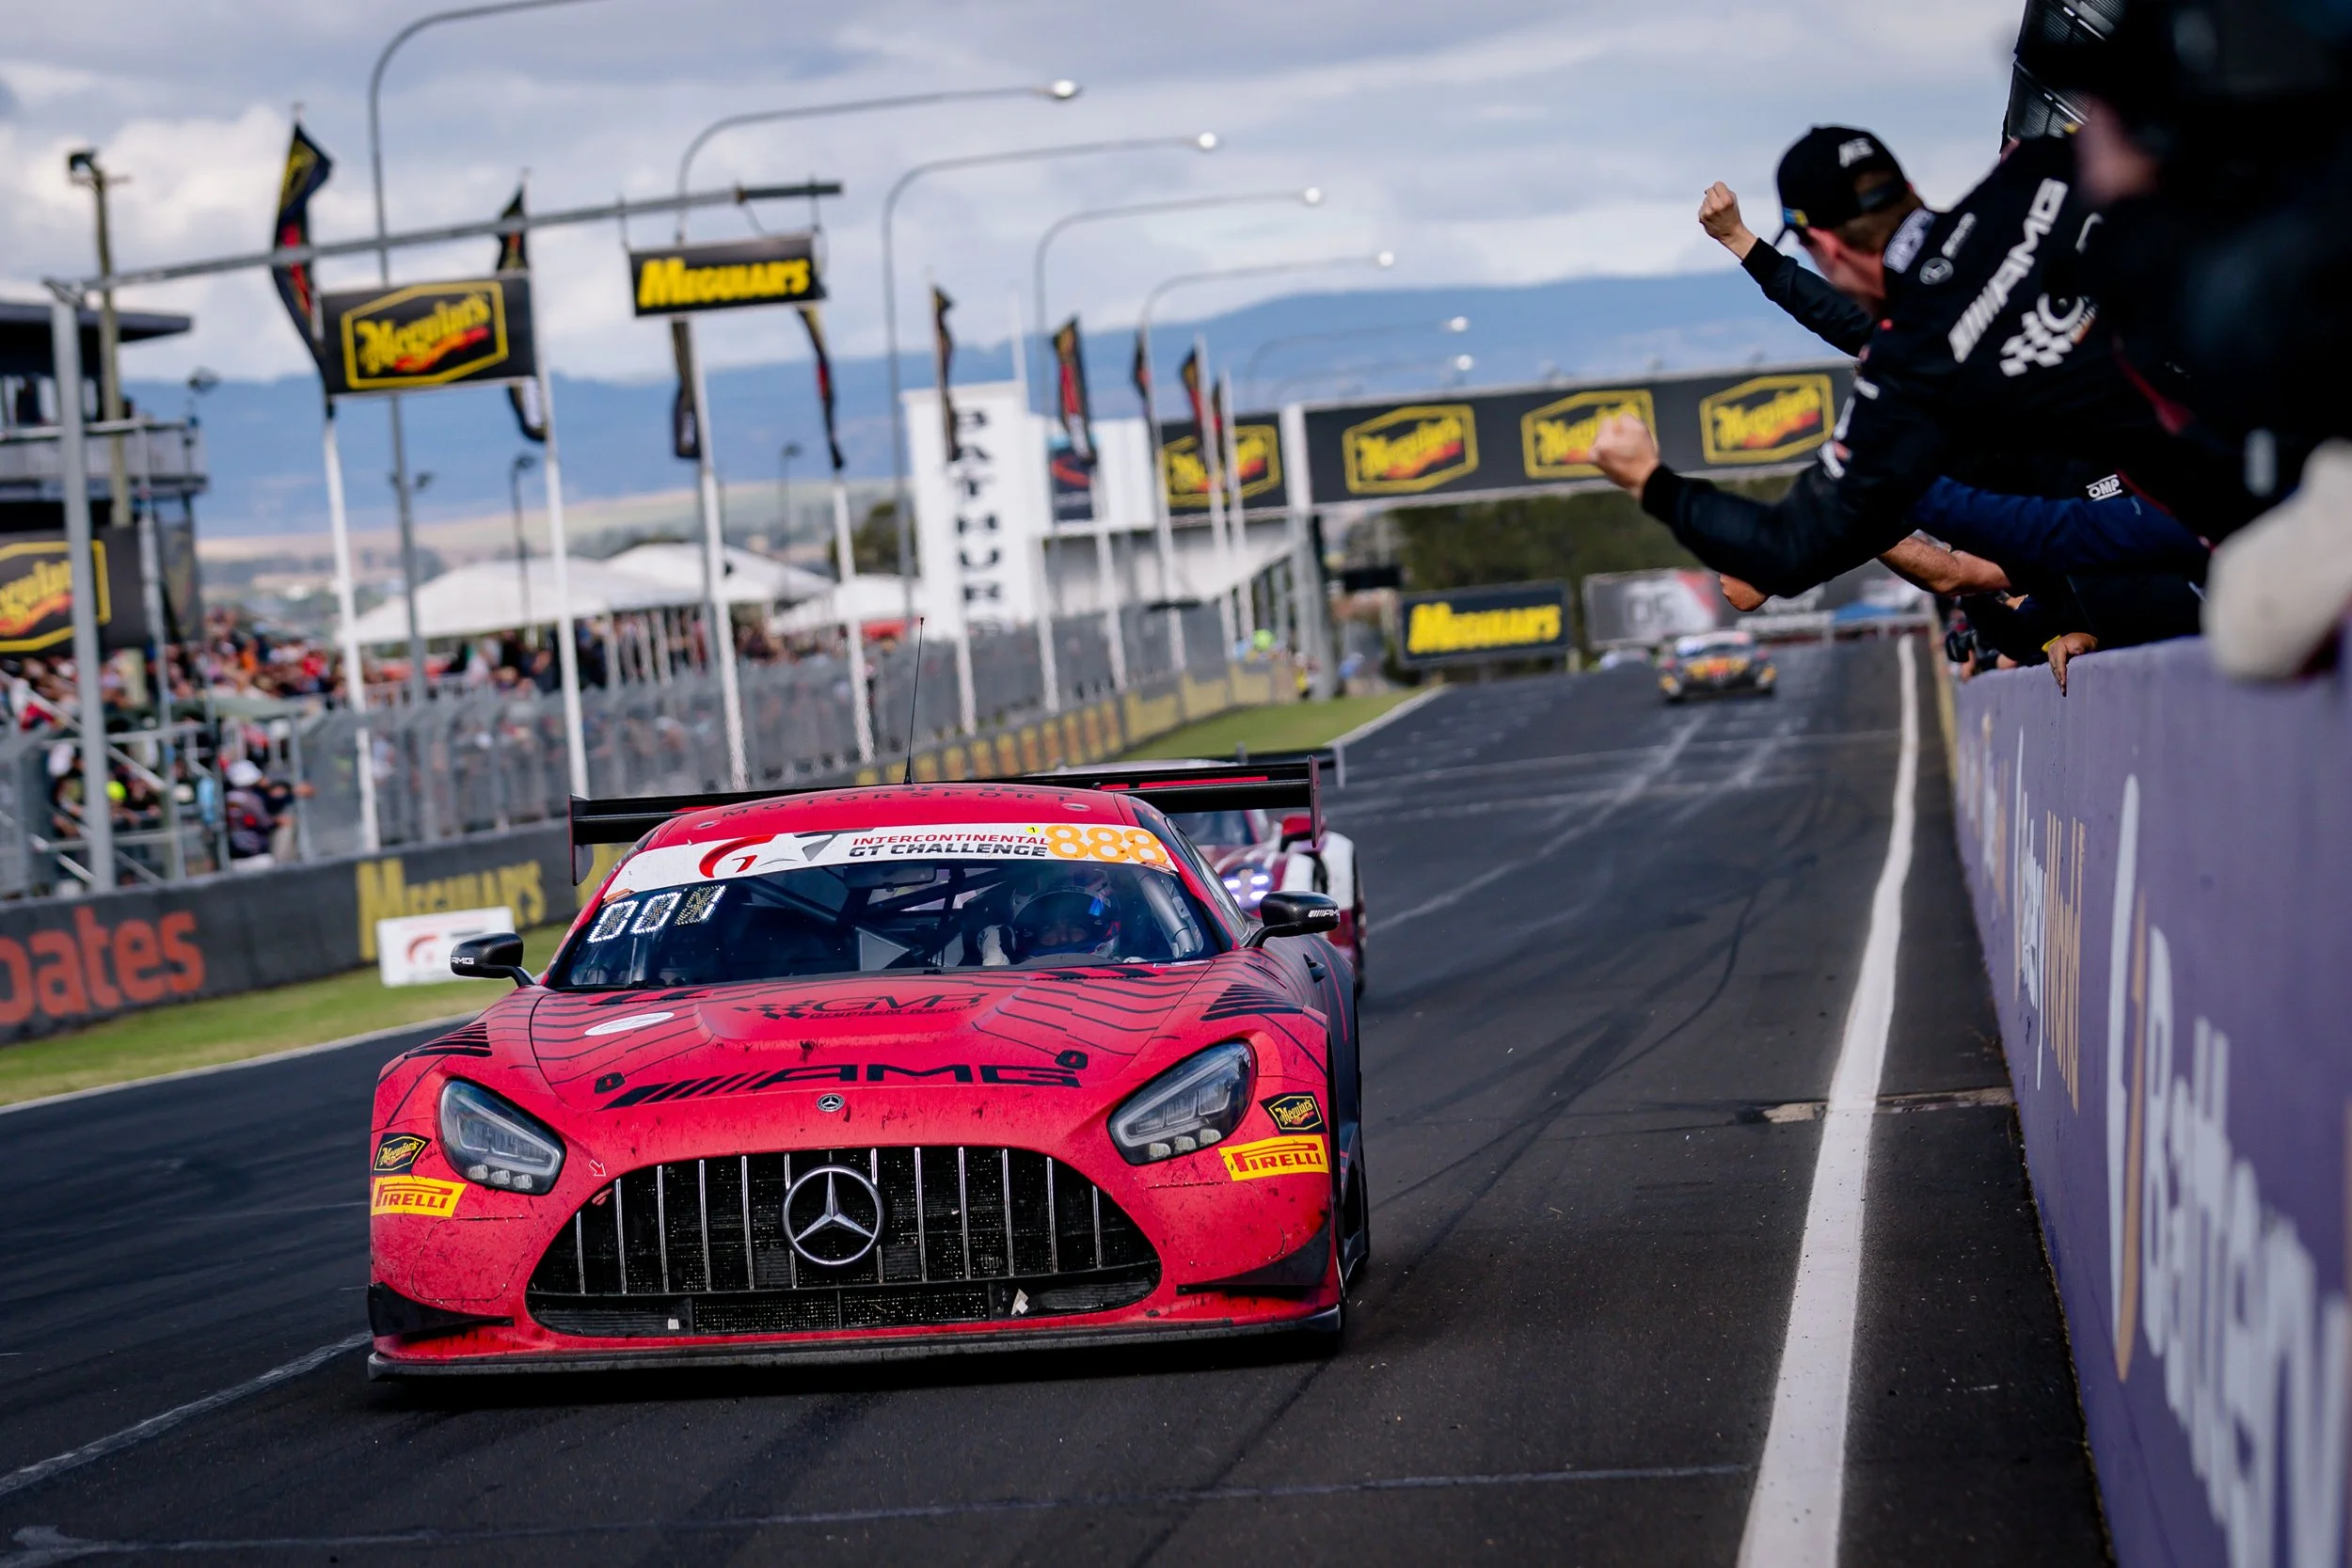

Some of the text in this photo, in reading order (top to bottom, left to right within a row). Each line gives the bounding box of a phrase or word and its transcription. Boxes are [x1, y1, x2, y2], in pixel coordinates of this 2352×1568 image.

[2089, 478, 2120, 498] OMP
[723, 789, 1074, 817] MOTORSPORT
[849, 843, 1048, 858] GT CHALLENGE
[852, 833, 1050, 846] INTERCONTINENTAL
[1044, 825, 1168, 863] 888
[451, 956, 474, 965] AMG
[2045, 810, 2084, 1116] World
[748, 1064, 1083, 1091] AMG
[1232, 1142, 1322, 1172] PIRELLI
[374, 1182, 453, 1209] PIRELLI
